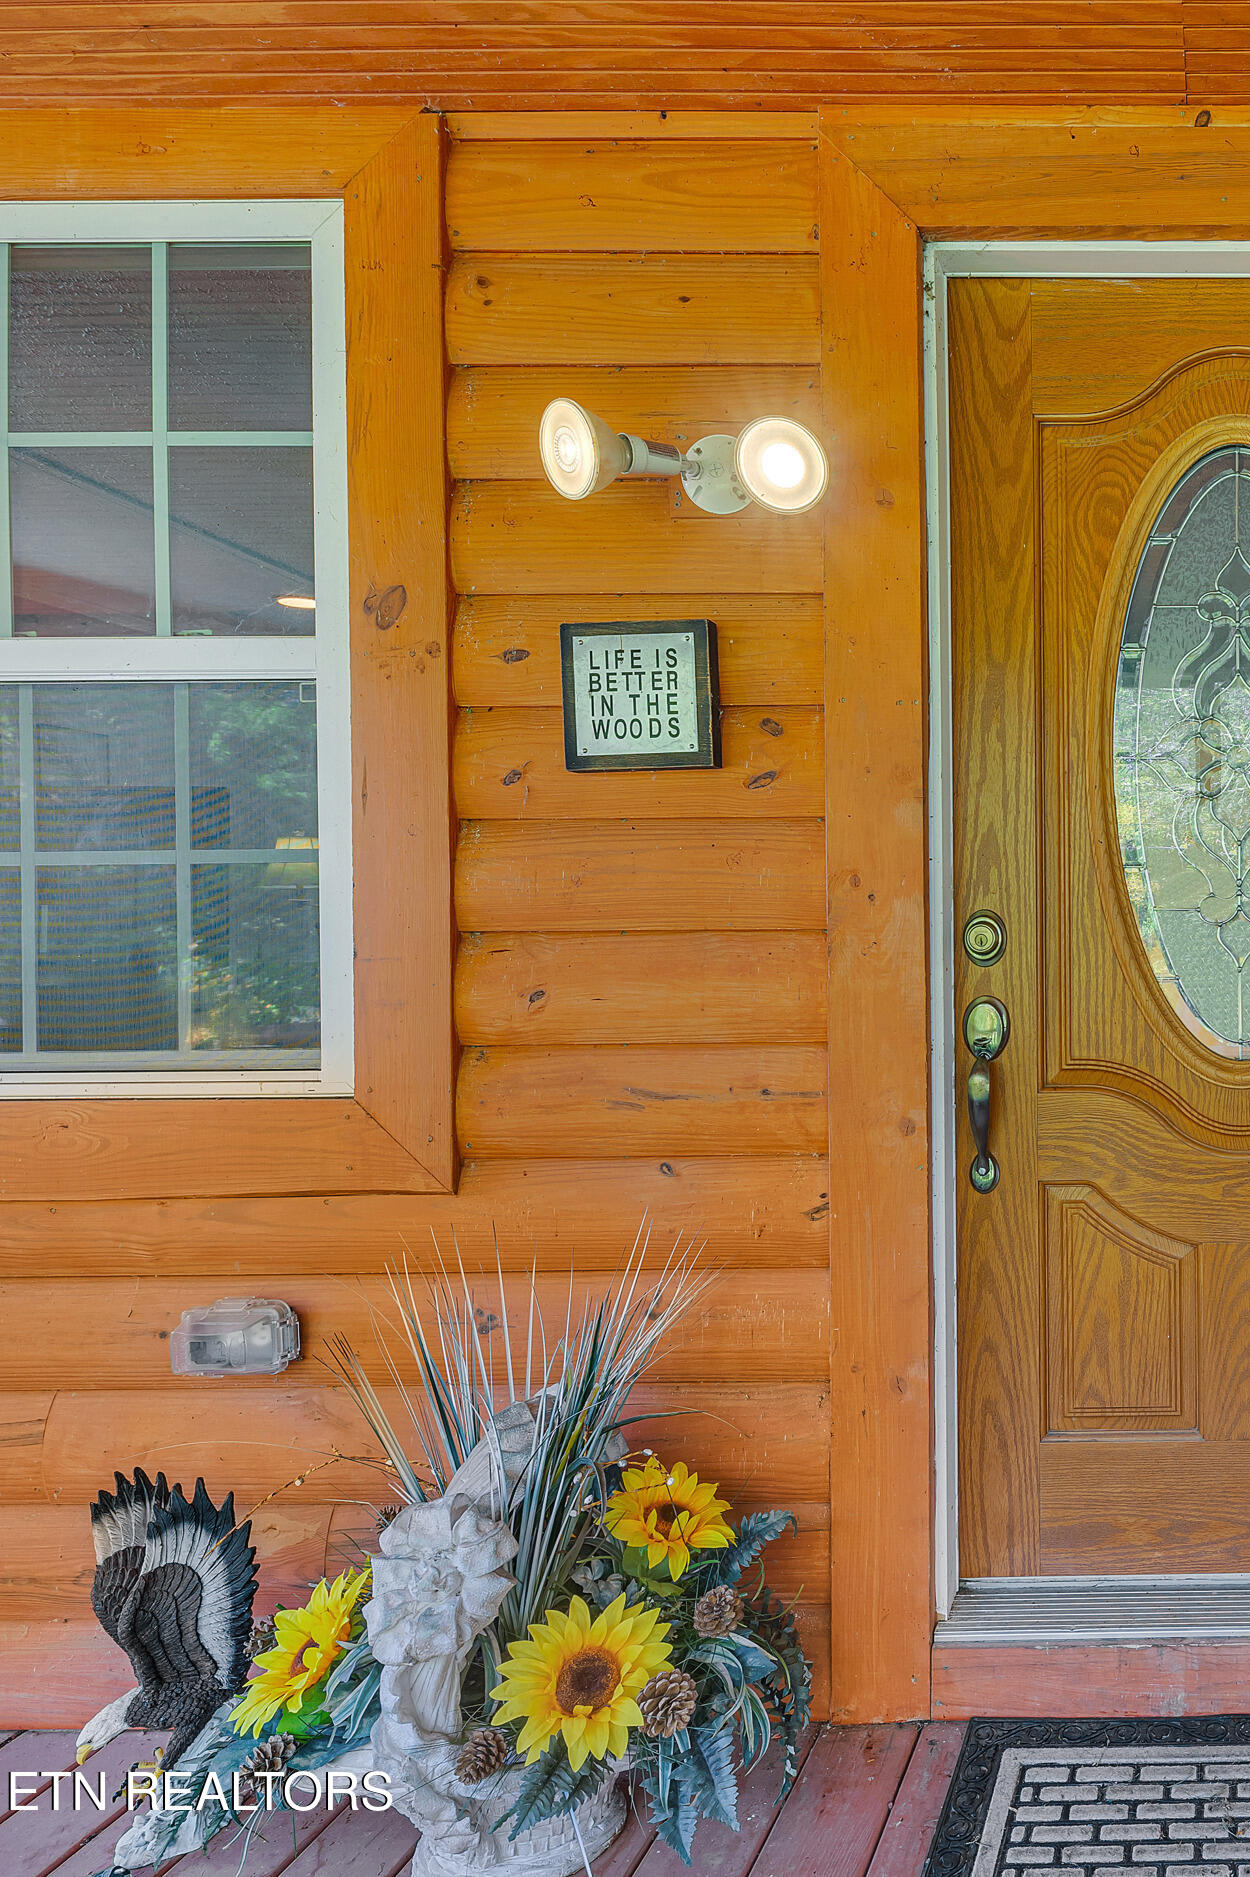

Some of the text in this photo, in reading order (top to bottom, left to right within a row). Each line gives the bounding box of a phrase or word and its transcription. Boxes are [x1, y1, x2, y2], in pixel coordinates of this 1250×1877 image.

[589, 648, 678, 670] LIFE IS
[589, 670, 678, 692] BETTER
[591, 693, 679, 717] IN THE
[592, 717, 680, 740] WOODS
